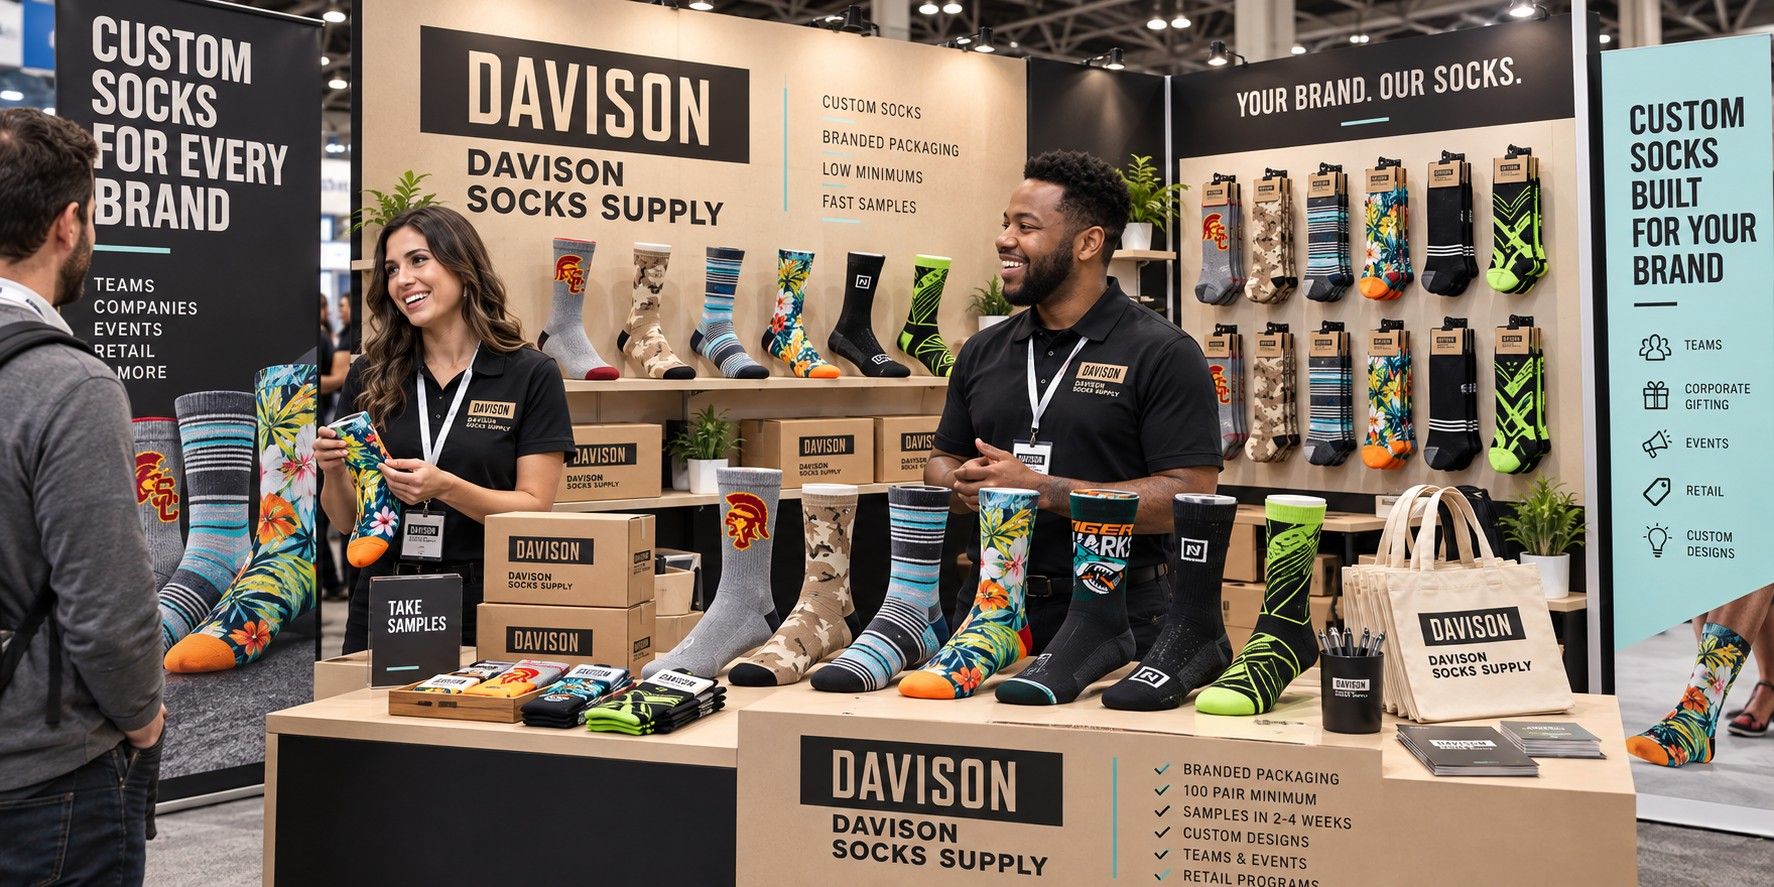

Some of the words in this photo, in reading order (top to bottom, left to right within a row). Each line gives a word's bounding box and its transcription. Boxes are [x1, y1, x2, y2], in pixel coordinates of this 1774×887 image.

[93, 16, 251, 84] CUSTOM
[1237, 88, 1287, 117] YOUR
[1296, 77, 1371, 110] BRAND.
[1380, 69, 1424, 99] OUR
[1434, 57, 1521, 93] SOCKS.
[92, 69, 217, 128] SOCKS
[469, 50, 709, 146] DAVISON
[823, 95, 876, 114] CUSTOM
[881, 102, 921, 119] SOCKS
[1630, 97, 1744, 135] CUSTOM
[823, 130, 884, 149] BRANDED
[890, 138, 959, 157] PACKAGING
[94, 123, 167, 175] FOR
[180, 133, 288, 186] EVERY
[1631, 137, 1718, 172] SOCKS
[468, 149, 623, 186] DAVISON
[823, 162, 851, 177] LOW
[857, 166, 922, 183] MINIMUMS
[1632, 177, 1702, 210] BUILT
[95, 178, 230, 232] BRAND
[467, 185, 586, 218] SOCKS
[601, 194, 723, 226] SUPPLY
[823, 195, 854, 209] FAST
[859, 197, 916, 214] SAMPLES
[1633, 217, 1680, 247] FOR
[1688, 213, 1756, 244] YOUR
[1634, 253, 1723, 285] BRAND
[94, 277, 154, 292] TEAMS
[94, 300, 197, 315] COMPANIES
[95, 322, 162, 336] EVENTS
[95, 344, 154, 358] RETAIL
[1685, 339, 1722, 350] TEAMS
[118, 366, 167, 379] MORE
[1082, 365, 1121, 379] DAVISON
[1685, 384, 1750, 394] CORPORATE
[473, 403, 510, 415] DAVISON
[1686, 399, 1728, 410] GIFTING
[804, 438, 846, 454] DAVISON
[905, 435, 935, 449] DAVIS
[1687, 438, 1728, 449] EVENTS
[567, 474, 603, 482] DAVISON
[1687, 485, 1724, 497] RETAIL
[1687, 530, 1732, 542] CUSTOM
[516, 540, 580, 561] DAVISON
[1688, 546, 1734, 559] DESIGNS
[509, 572, 551, 581] DAVISON
[509, 581, 537, 589] SOCKS
[541, 582, 572, 590] SUPPLY
[388, 600, 422, 615] TAKE
[388, 616, 446, 633] SAMPLES
[1429, 613, 1513, 642] DAVISON
[514, 630, 579, 652] DAVISON
[1429, 652, 1487, 665] DAVISON
[1433, 666, 1476, 678] SOCKS
[1482, 661, 1531, 674] SUPPLY
[1336, 680, 1365, 689] DAVISON
[832, 749, 1016, 812] DAVISON
[1184, 763, 1250, 779] BRANDED
[1257, 768, 1339, 785] PACKAGING
[1184, 785, 1207, 797] 100
[1214, 787, 1244, 800] PAIR
[1251, 789, 1316, 805] MINIMUM
[1184, 806, 1248, 821] SAMPLES
[1255, 811, 1267, 823] IN
[1274, 813, 1296, 825] 2-4
[1302, 815, 1351, 829] WEEKS
[833, 814, 957, 843] DAVISON
[1184, 827, 1241, 842] CUSTOM
[1248, 832, 1309, 847] DESIGNS
[832, 839, 927, 865] SOCKS
[940, 849, 1048, 876] SUPPLY
[1184, 848, 1231, 863] TEAMS
[1237, 853, 1246, 864] &
[1252, 854, 1306, 869] EVENTS
[1184, 870, 1232, 885] RETAIL
